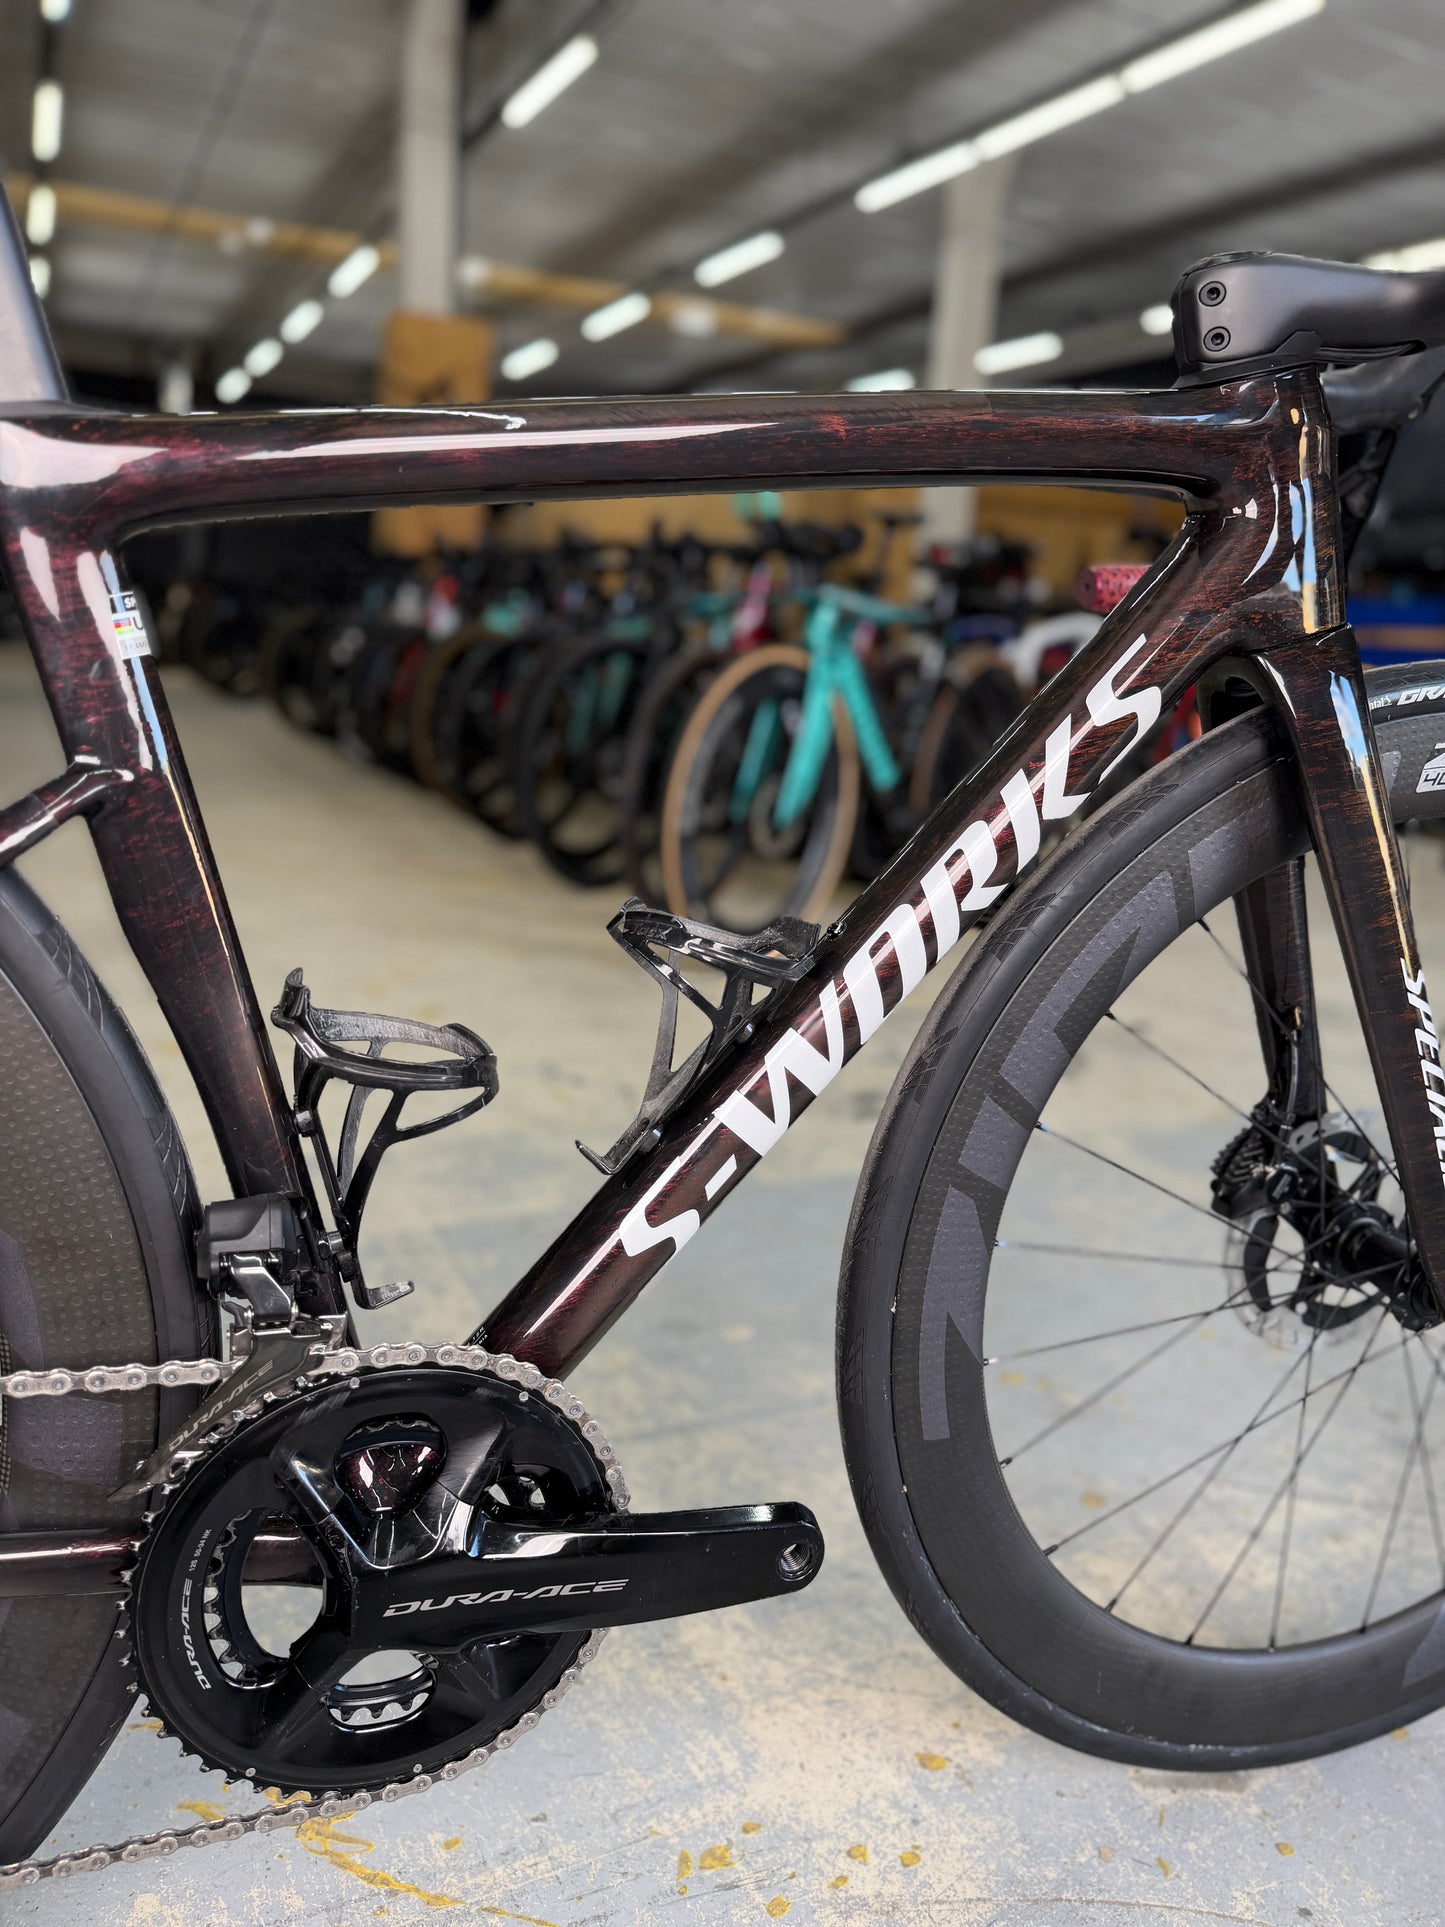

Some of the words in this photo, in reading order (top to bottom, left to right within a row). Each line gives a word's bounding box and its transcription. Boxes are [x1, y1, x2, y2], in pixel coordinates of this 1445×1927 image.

[618, 634, 1162, 1257] S-WORKS
[169, 1360, 274, 1452] DURA-ACE
[181, 1577, 212, 1690] DURA-ACE
[382, 1578, 629, 1618] DURA-ACE
